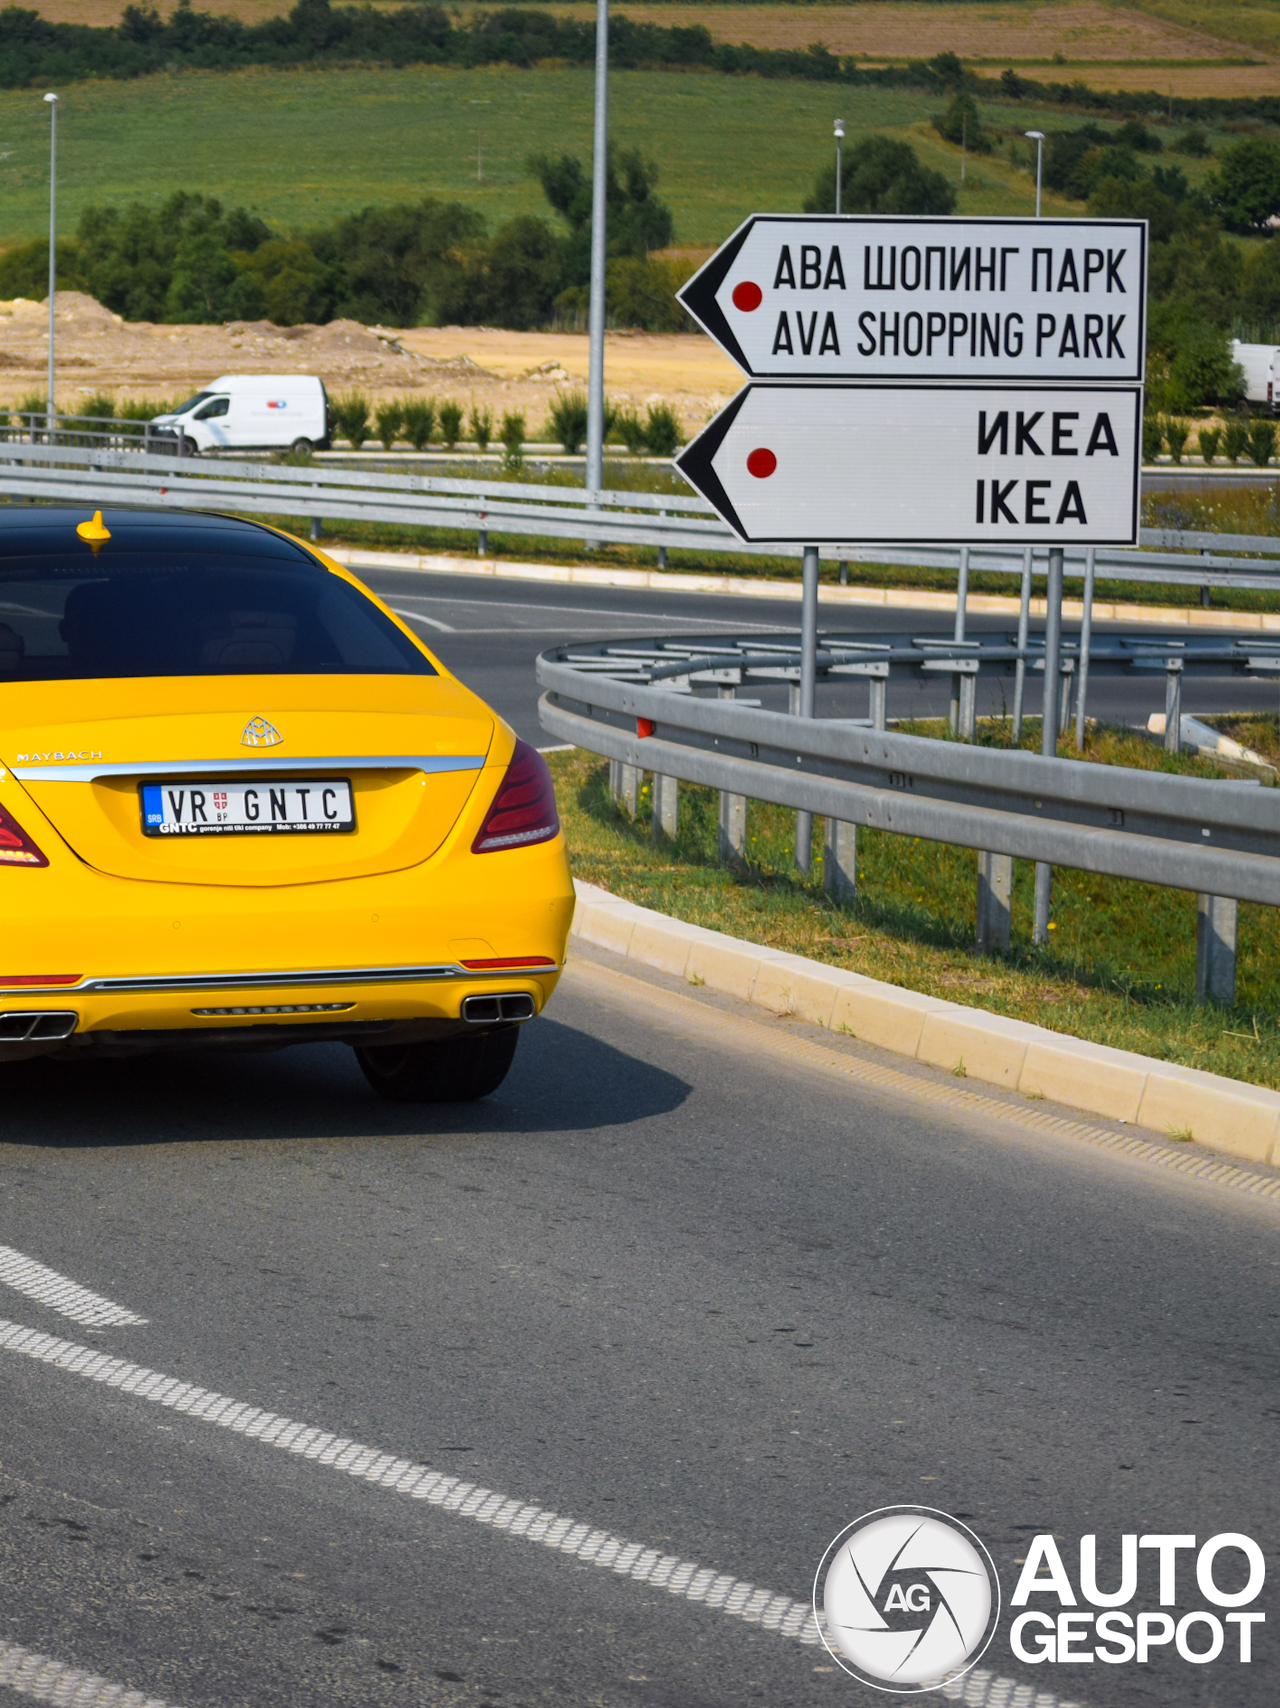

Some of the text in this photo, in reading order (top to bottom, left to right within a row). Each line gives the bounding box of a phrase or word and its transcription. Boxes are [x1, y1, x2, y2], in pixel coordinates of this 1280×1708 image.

[773, 244, 1128, 294] АВА ШОПИНГ ПАРК
[771, 310, 1127, 359] AVA SHOPPING PARK
[976, 410, 1119, 457] ИКЕА
[975, 479, 1088, 525] IKEA
[16, 750, 103, 763] MAYBACH
[147, 813, 162, 823] SRB
[167, 788, 338, 823] VR GNTC
[159, 822, 198, 834] GNTC
